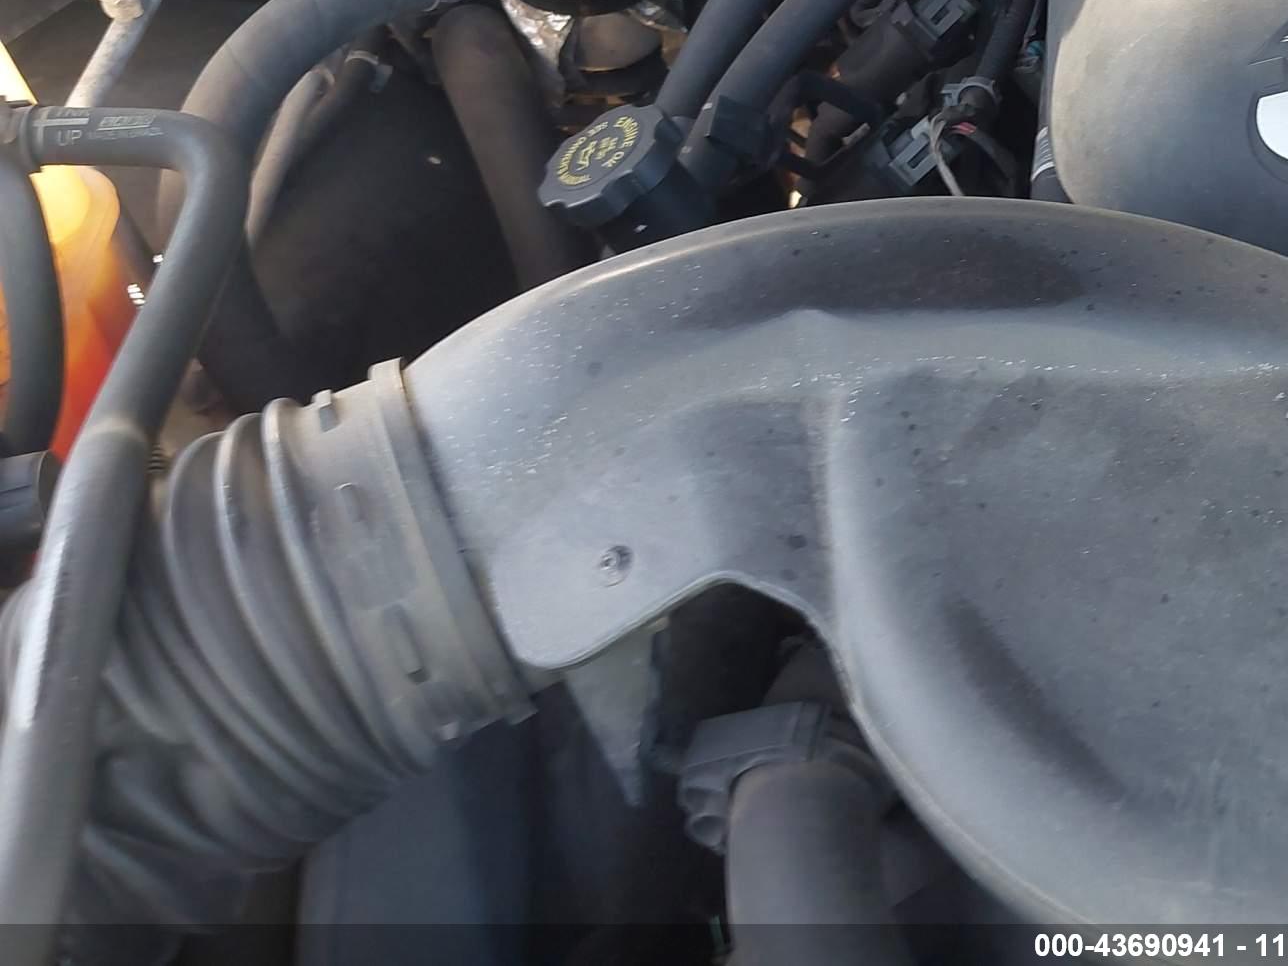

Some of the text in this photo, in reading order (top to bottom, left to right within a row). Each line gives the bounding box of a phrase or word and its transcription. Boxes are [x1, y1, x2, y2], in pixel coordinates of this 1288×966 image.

[57, 129, 82, 146] UP
[613, 116, 639, 149] ENGINE
[601, 151, 625, 167] OIL
